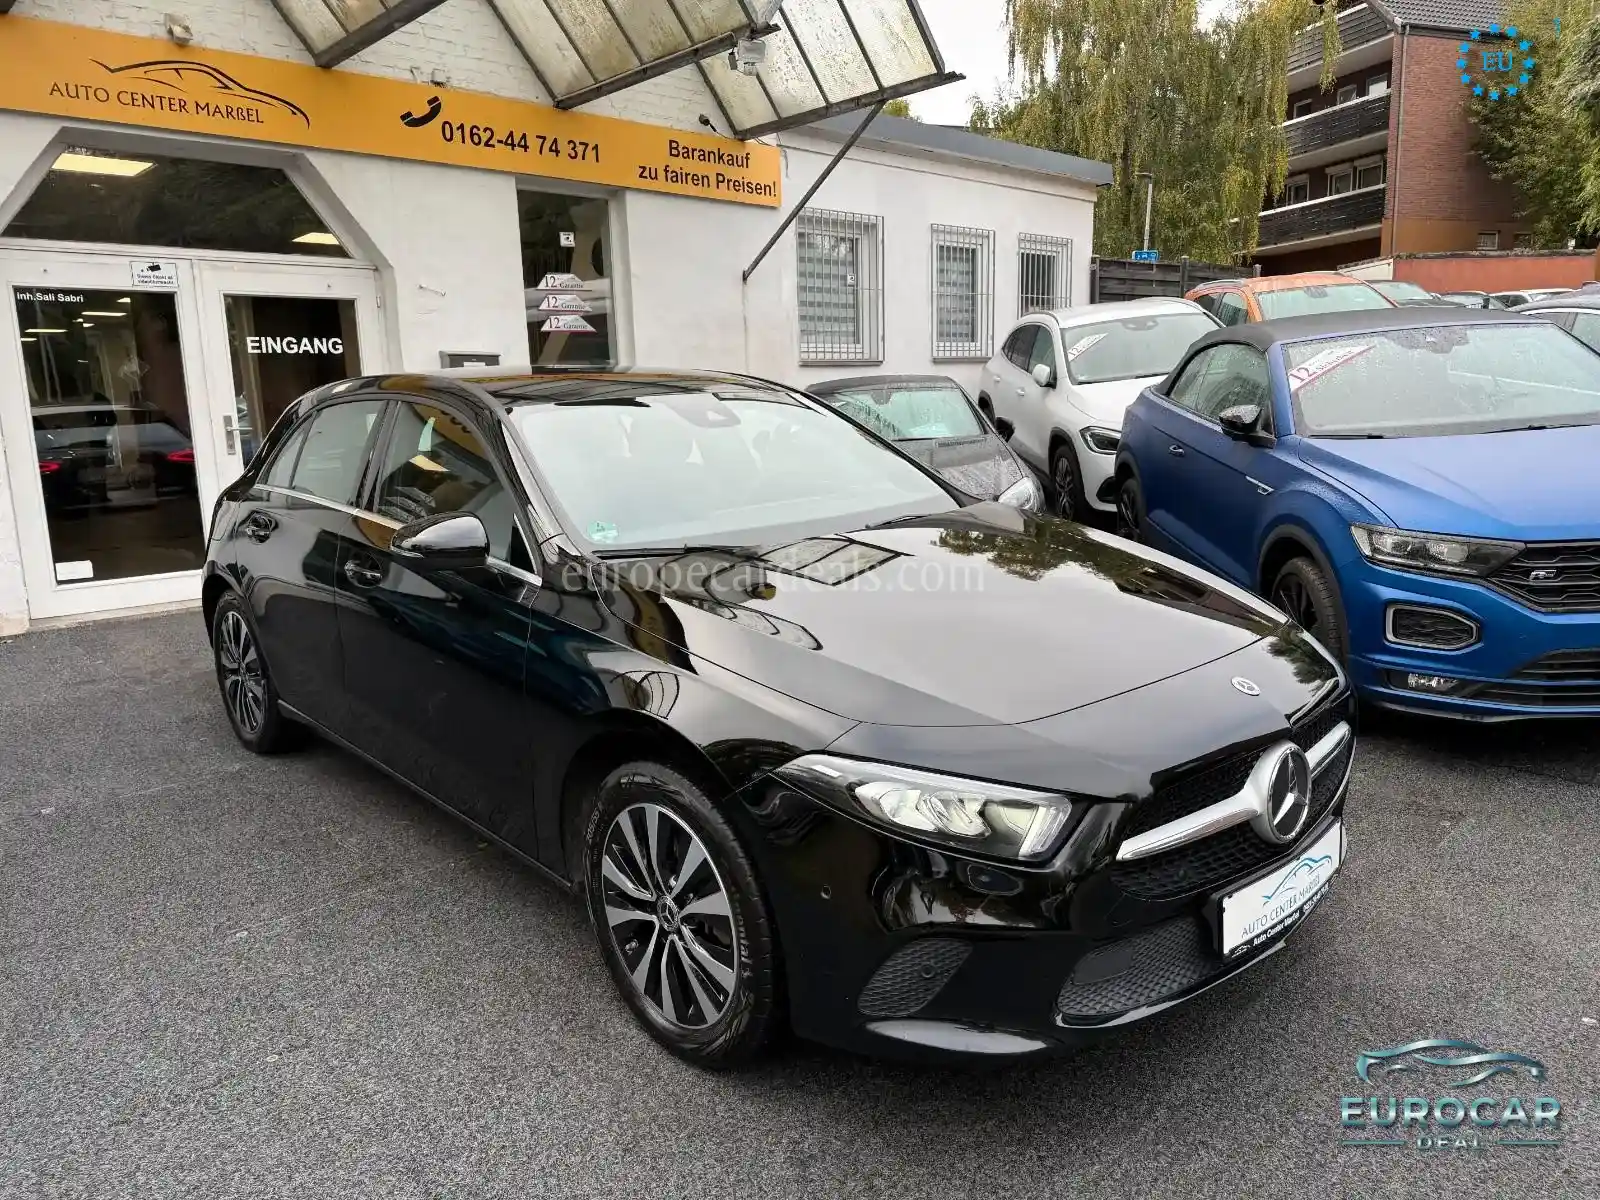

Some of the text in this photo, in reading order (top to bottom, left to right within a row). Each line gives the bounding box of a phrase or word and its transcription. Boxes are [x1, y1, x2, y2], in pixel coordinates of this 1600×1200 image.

[49, 81, 110, 103] AUTO
[116, 90, 189, 114] CENTER
[441, 120, 600, 163] 0162-44 74 371
[668, 139, 751, 169] Barankauf
[638, 164, 777, 198] zu fairen Preisen!
[544, 275, 557, 288] 12
[57, 293, 84, 303] Sabri
[546, 296, 559, 309] 12
[548, 317, 561, 329] 12
[246, 336, 344, 355] EINGANG
[1289, 367, 1319, 383] 12
[1241, 914, 1268, 939] AUTO
[1270, 895, 1298, 921] CENTER
[1253, 932, 1267, 947] Auto
